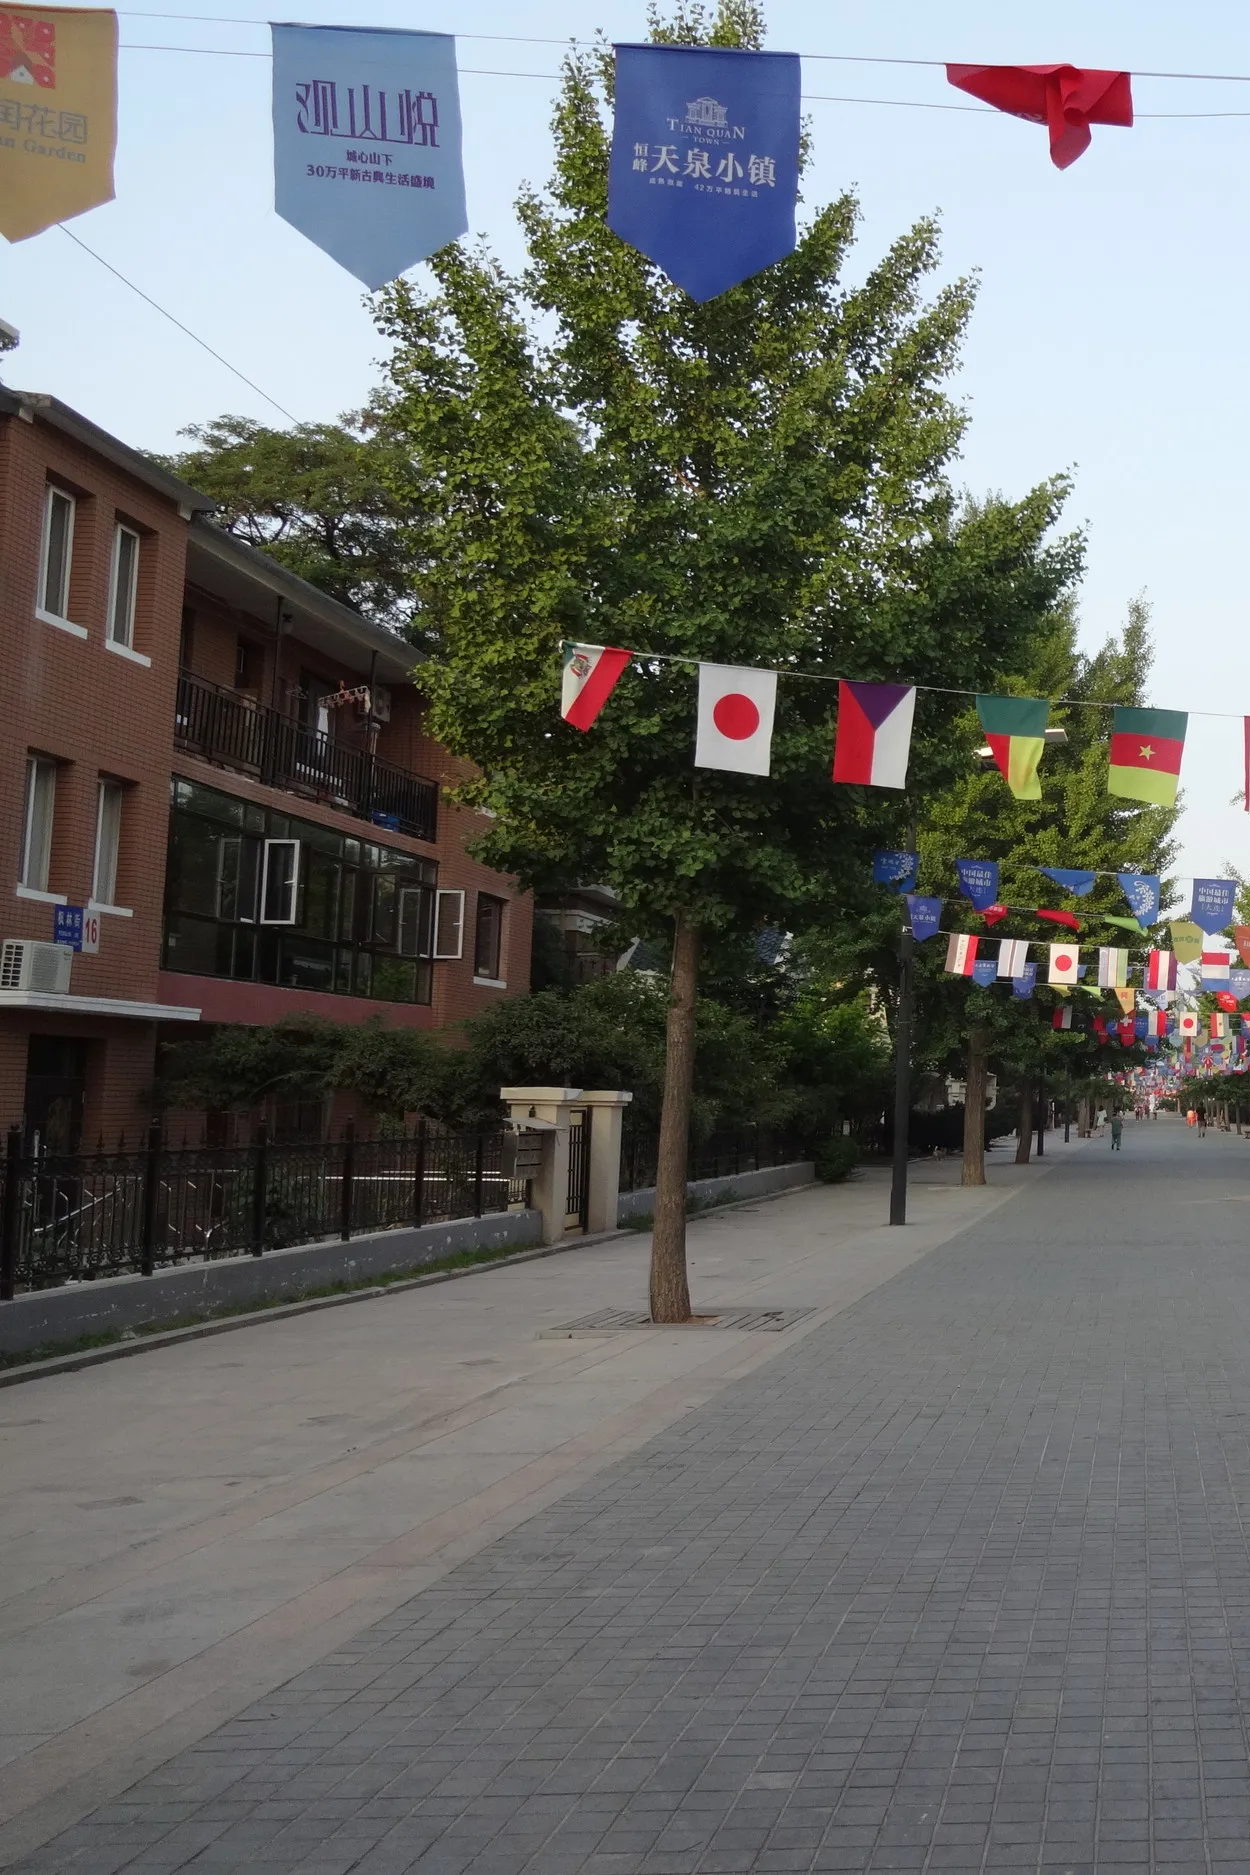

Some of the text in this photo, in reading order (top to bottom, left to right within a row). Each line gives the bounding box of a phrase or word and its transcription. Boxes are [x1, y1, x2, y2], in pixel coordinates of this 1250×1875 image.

[666, 118, 746, 140] TIAN QUAN
[693, 136, 720, 146] TOWN
[23, 138, 86, 163] Garden
[633, 142, 776, 188] 恒峰 天泉小镇
[85, 917, 98, 944] 16
